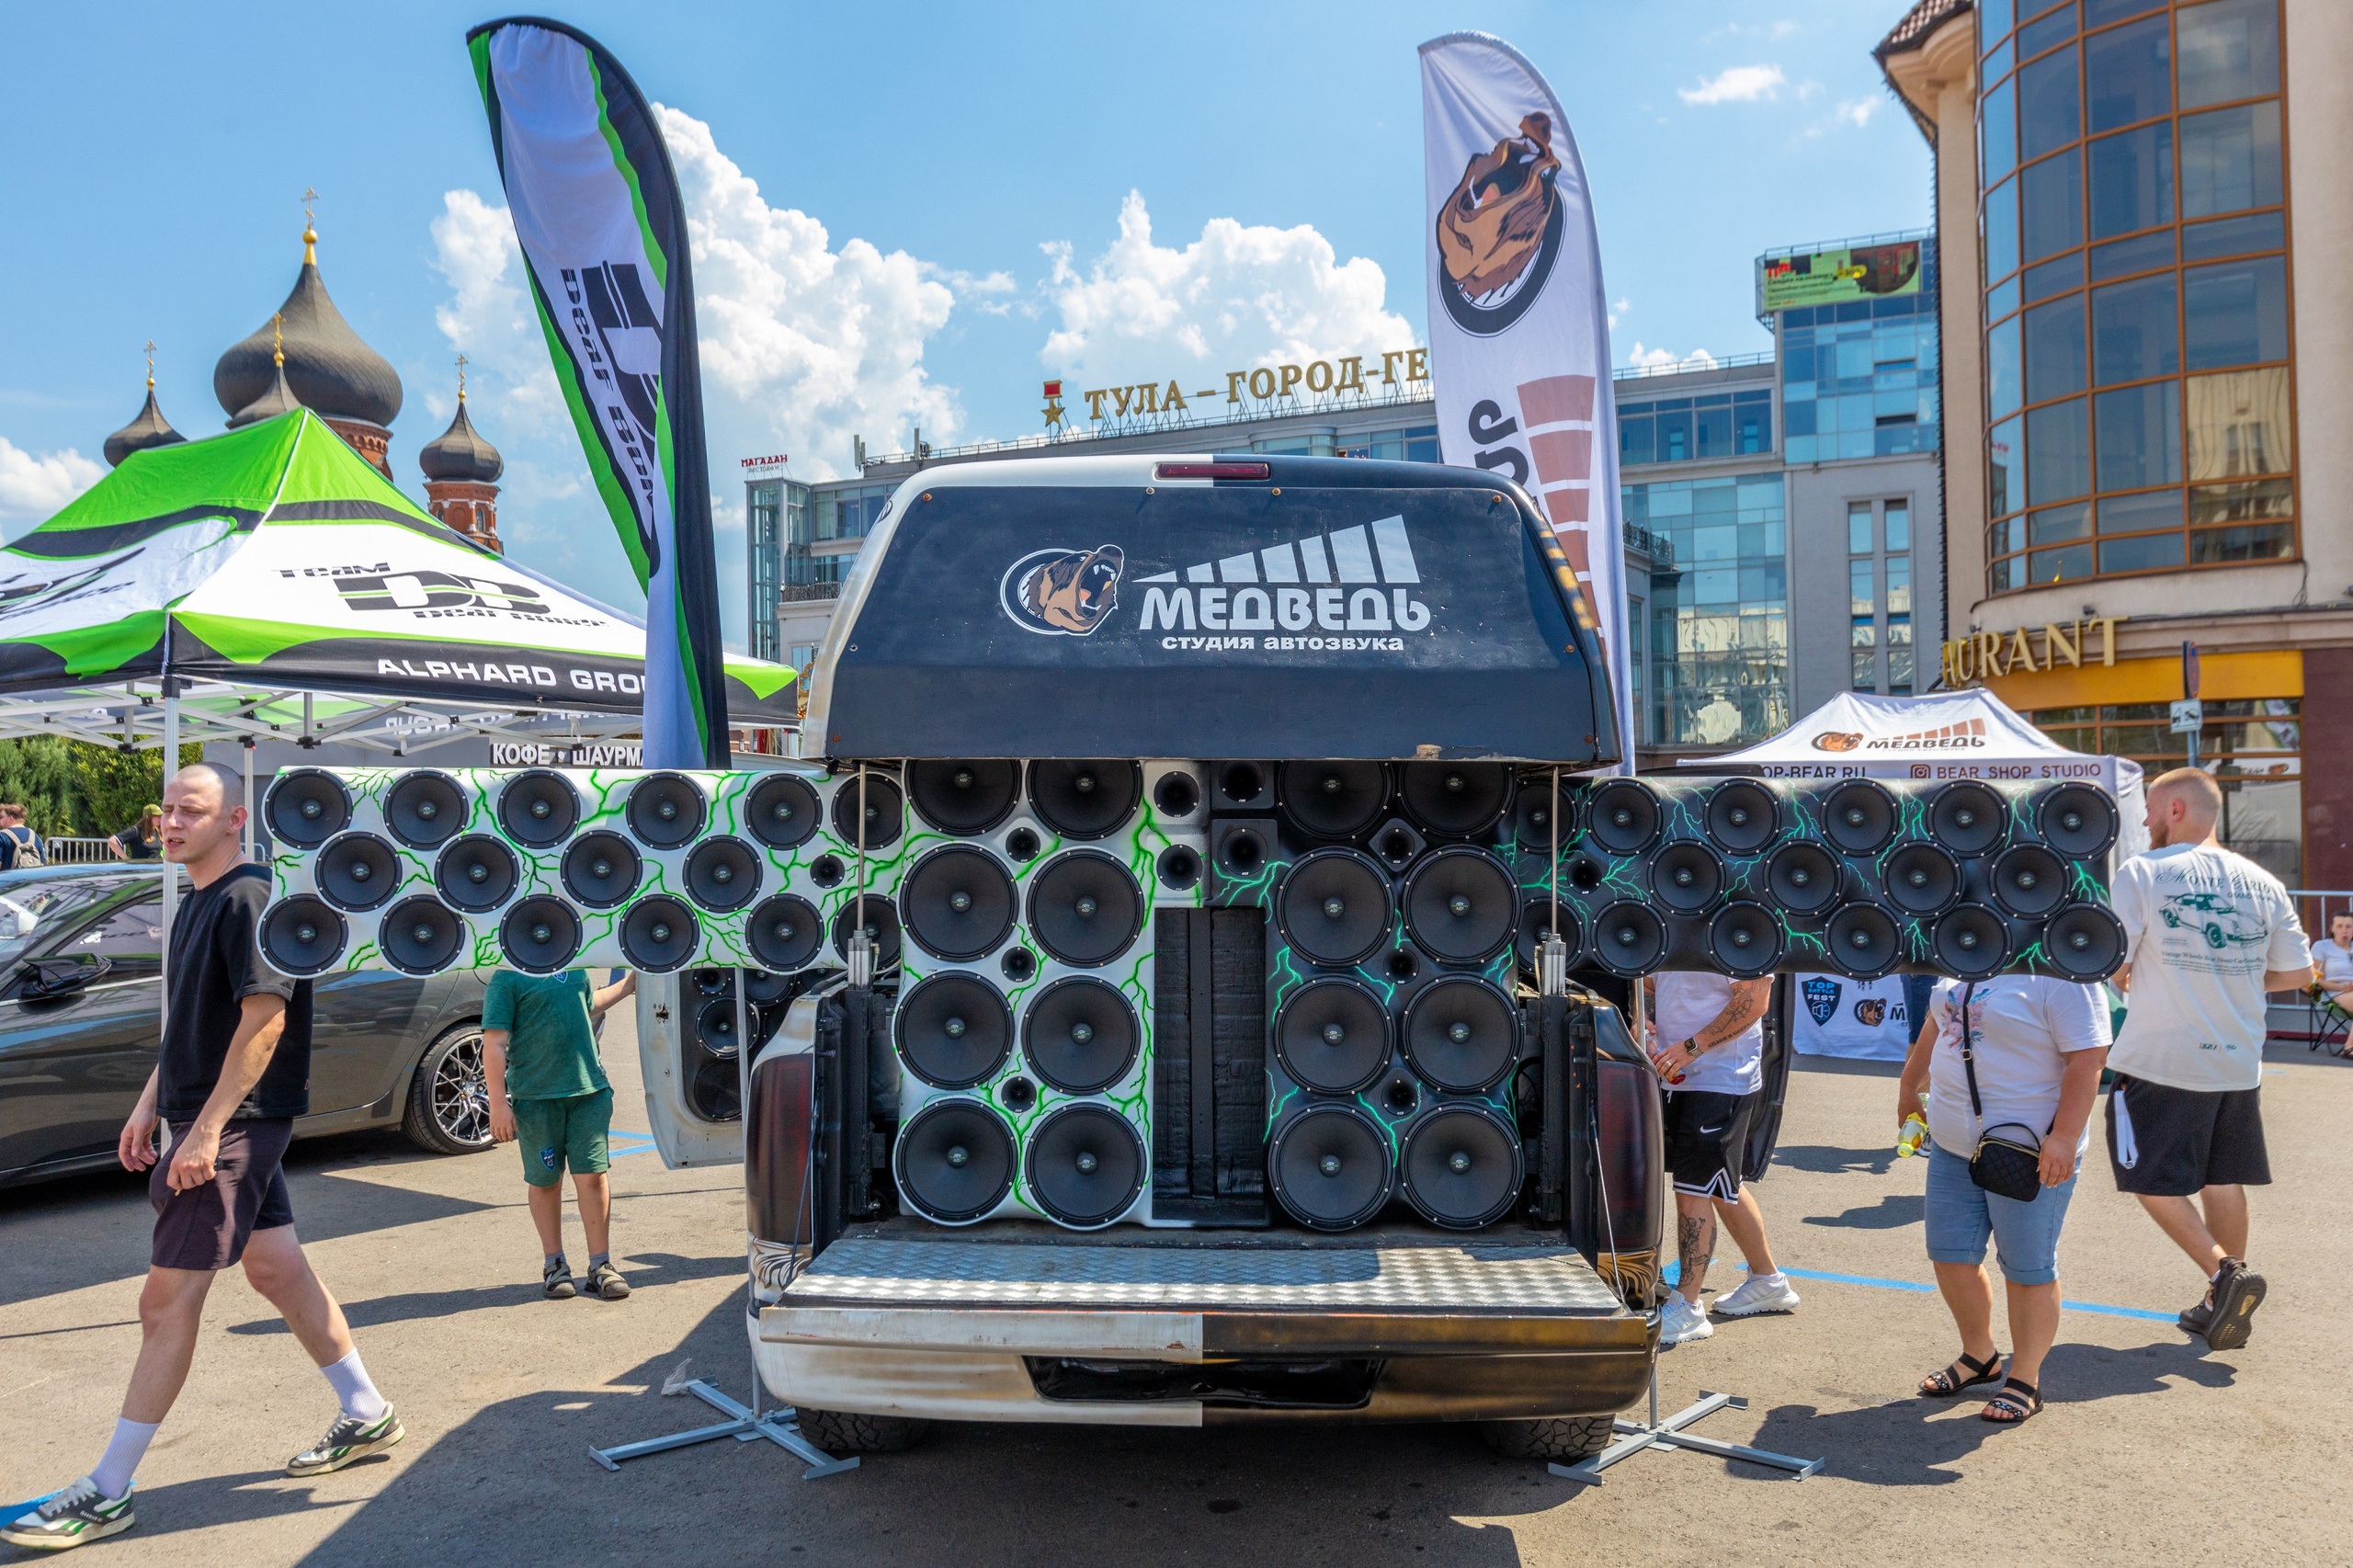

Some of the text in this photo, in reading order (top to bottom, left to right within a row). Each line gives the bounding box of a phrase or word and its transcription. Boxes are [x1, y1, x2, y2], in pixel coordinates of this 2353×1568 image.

[1086, 380, 1188, 419] ТУЛА
[1227, 347, 1429, 403] ГОРОД-ГЕ
[741, 454, 788, 468] МАГАДАН
[1139, 586, 1431, 631] МЕДВЕДЬ
[1162, 636, 1404, 652] студия автозвука
[378, 659, 645, 695] ALPHARD GRO
[1866, 737, 1985, 749] МЕДВЕДЬ
[493, 743, 551, 766] КОФЕ
[1807, 981, 1836, 990] TOP
